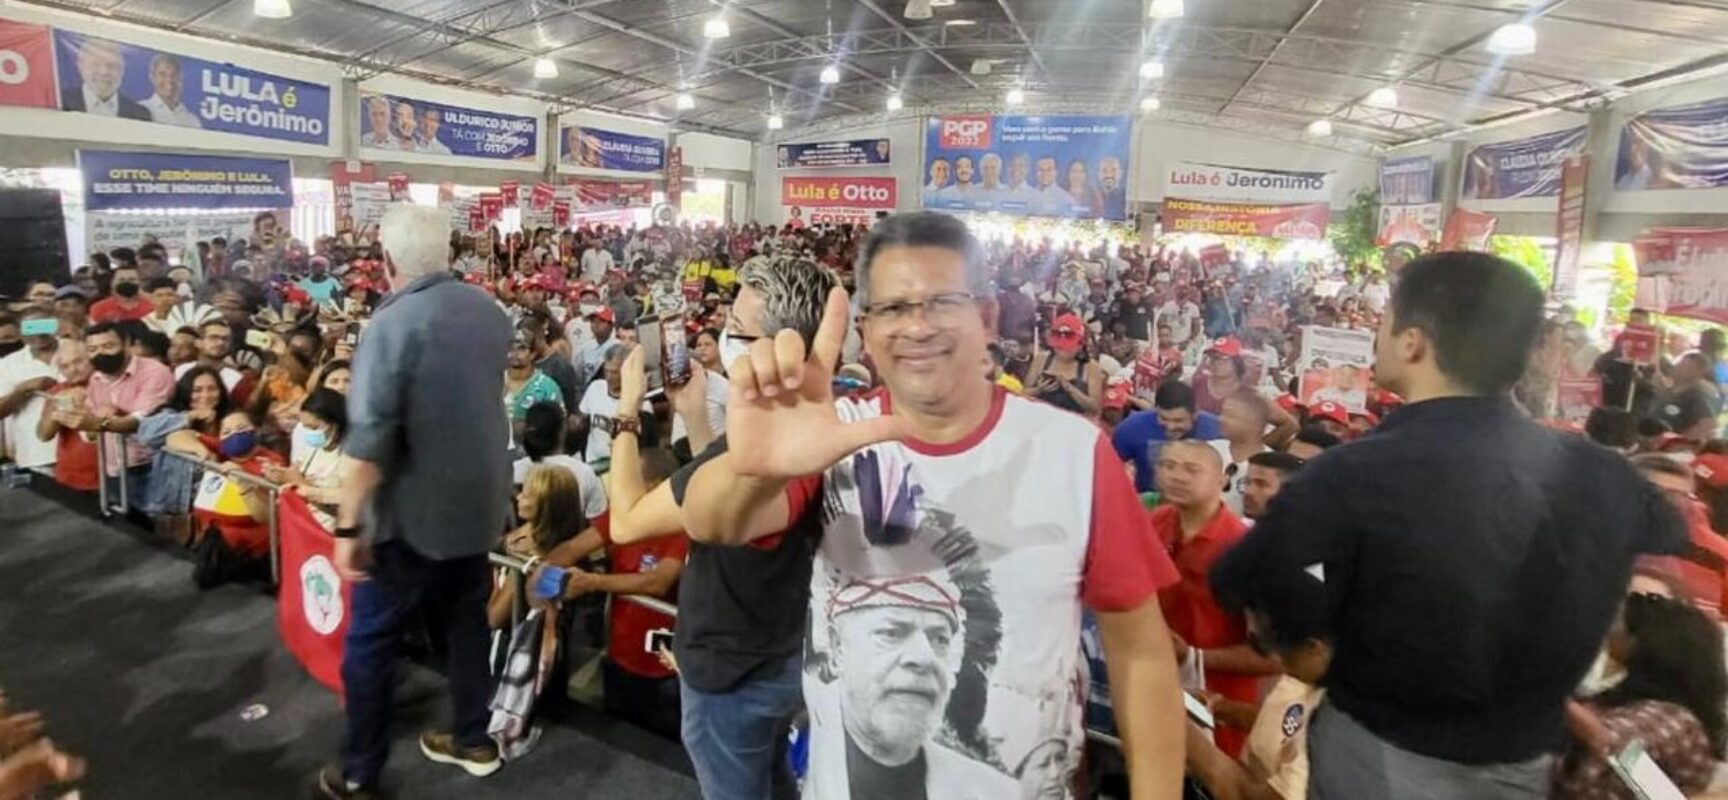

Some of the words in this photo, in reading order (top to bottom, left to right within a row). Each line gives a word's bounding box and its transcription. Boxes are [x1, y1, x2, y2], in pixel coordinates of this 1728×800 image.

[202, 69, 279, 105] LULA
[281, 86, 297, 108] é
[201, 97, 323, 135] Jerônimo
[444, 111, 499, 128] ULDURICO
[943, 119, 988, 137] PGP
[483, 143, 508, 154] OTTO
[950, 136, 981, 147] 2022
[109, 168, 154, 181] OTTO,
[157, 168, 226, 182] JERÔNIMO
[228, 171, 236, 182] E
[1170, 171, 1206, 186] Lula
[94, 183, 132, 194] ESSE
[136, 183, 169, 194] TIME
[789, 182, 825, 199] Lula
[827, 183, 840, 200] é
[843, 183, 889, 201] Otto
[1174, 218, 1258, 236] DIFERENÇA
